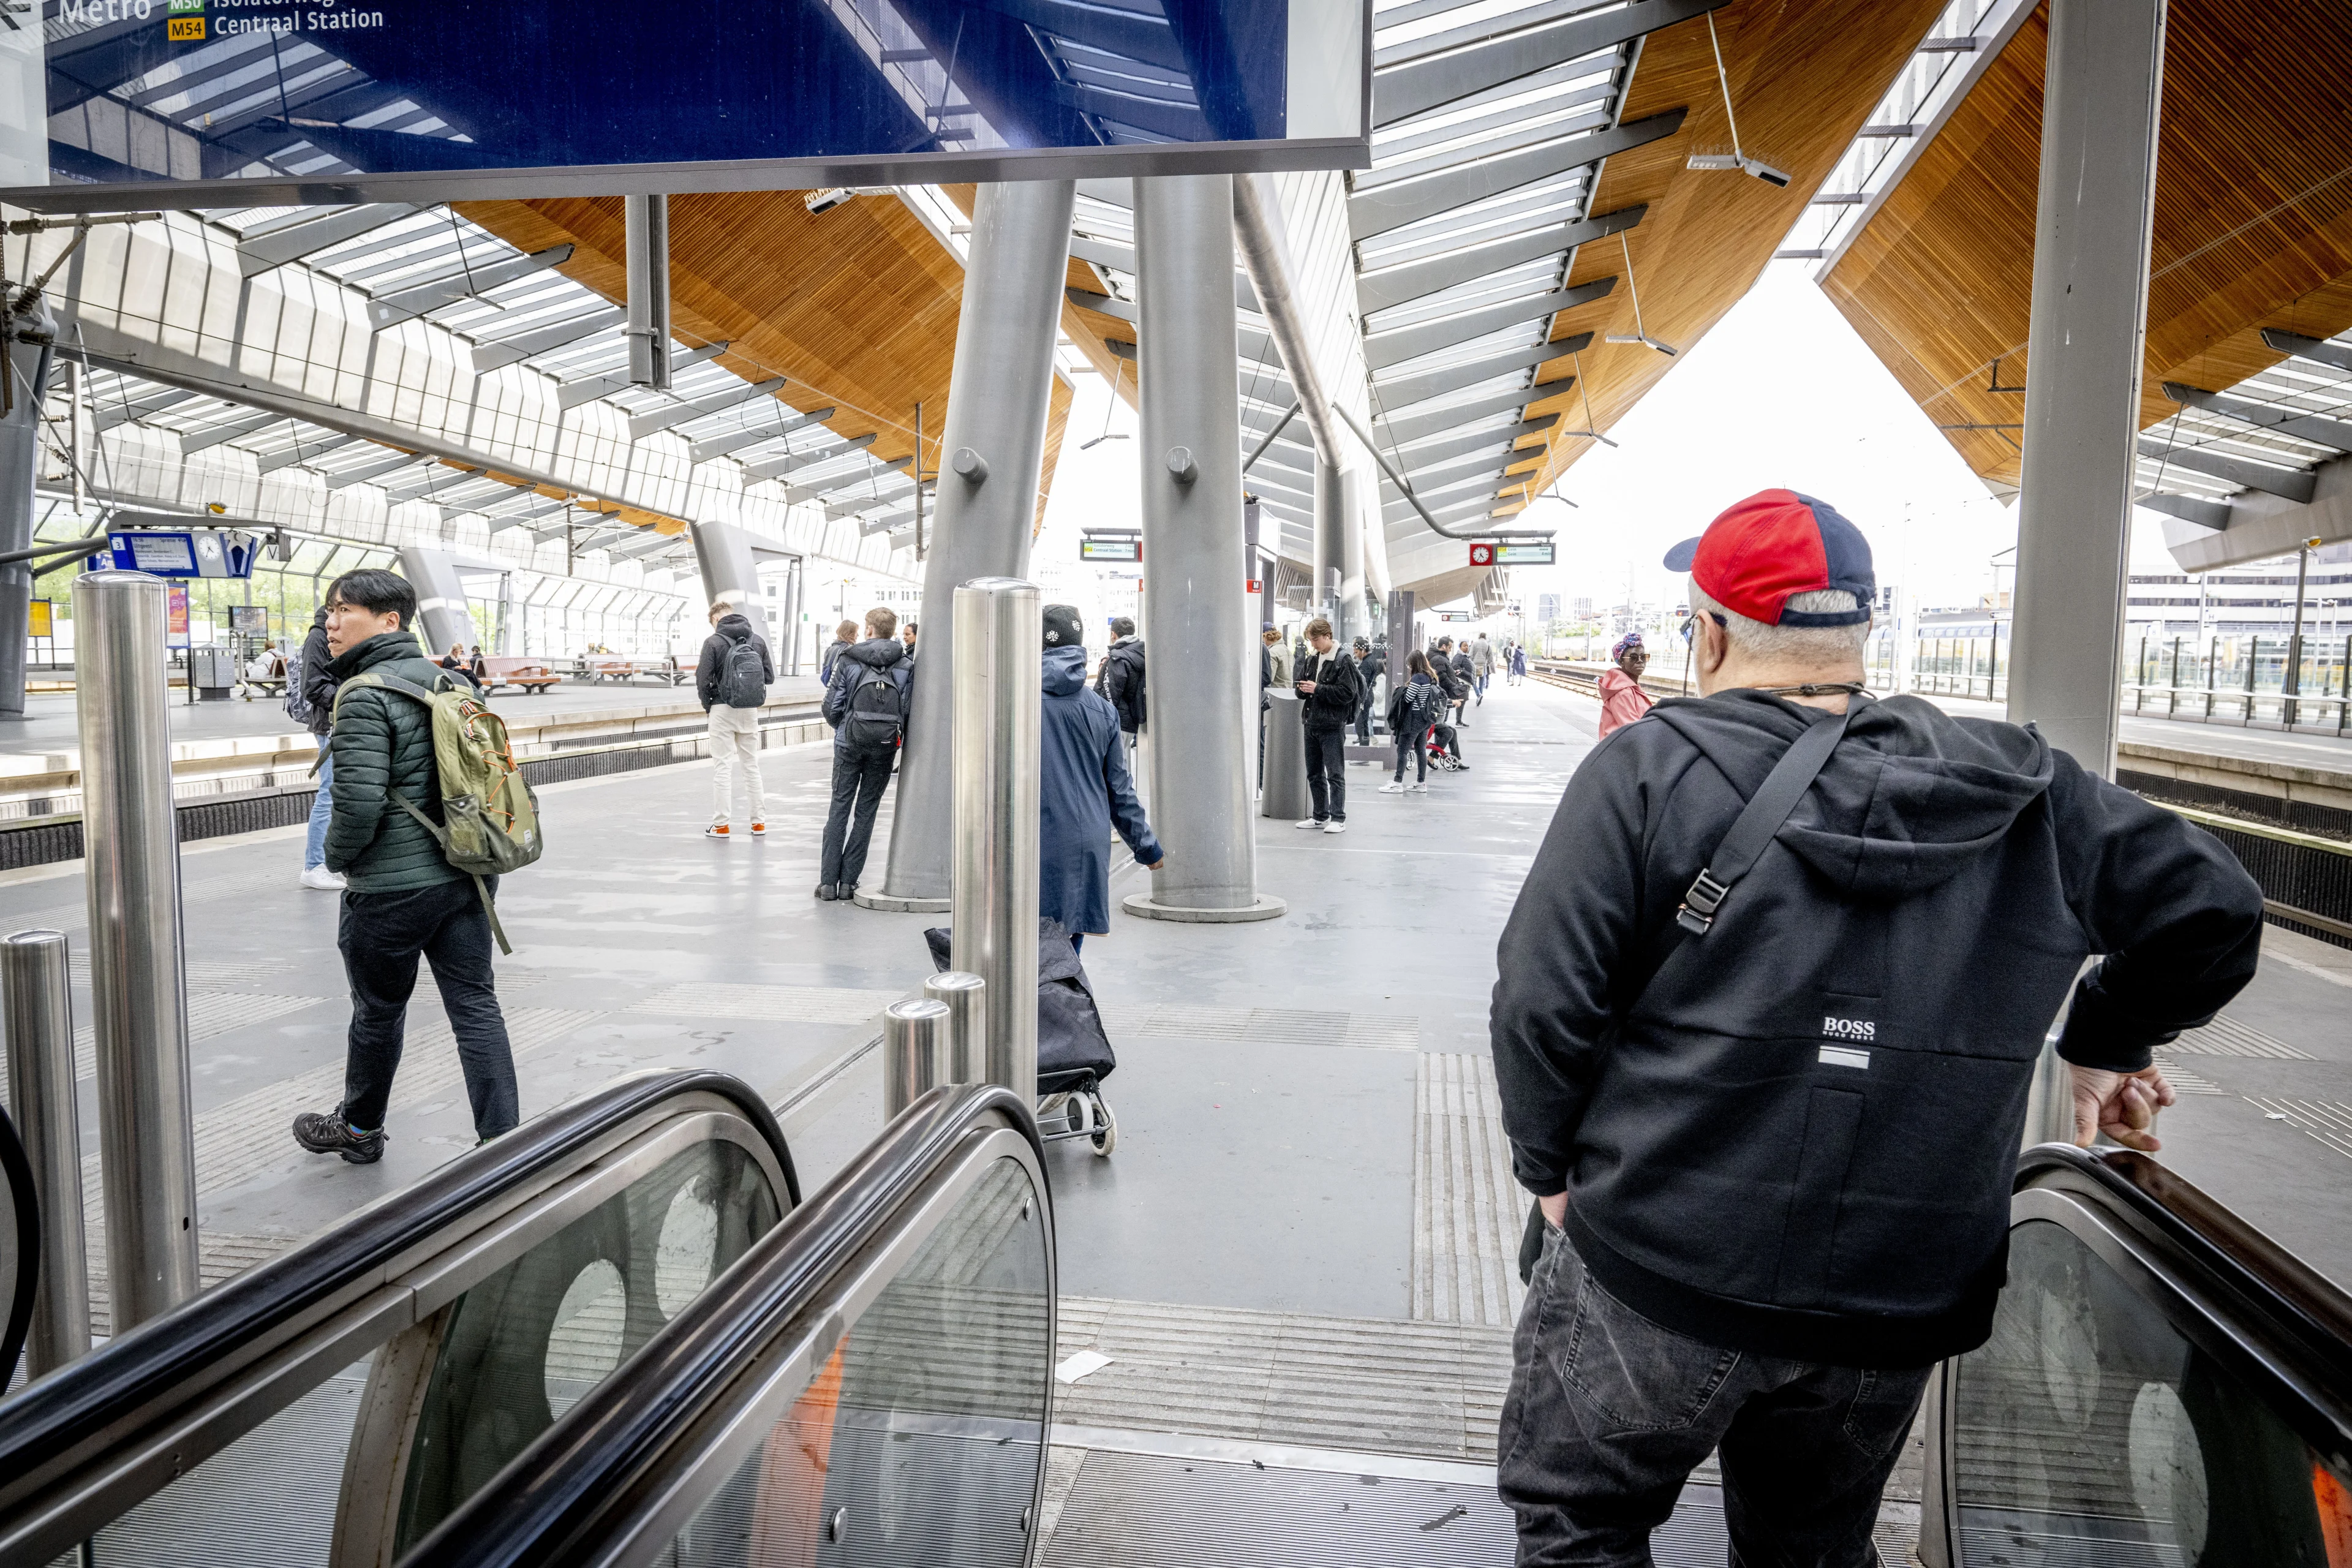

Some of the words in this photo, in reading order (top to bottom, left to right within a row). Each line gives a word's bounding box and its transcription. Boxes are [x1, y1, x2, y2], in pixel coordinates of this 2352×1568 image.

[59, 0, 151, 23] Metro
[172, 22, 202, 36] M54
[215, 10, 300, 34] Centraal
[307, 9, 383, 30] Station
[268, 546, 277, 559] V
[1824, 1017, 1875, 1036] BOSS
